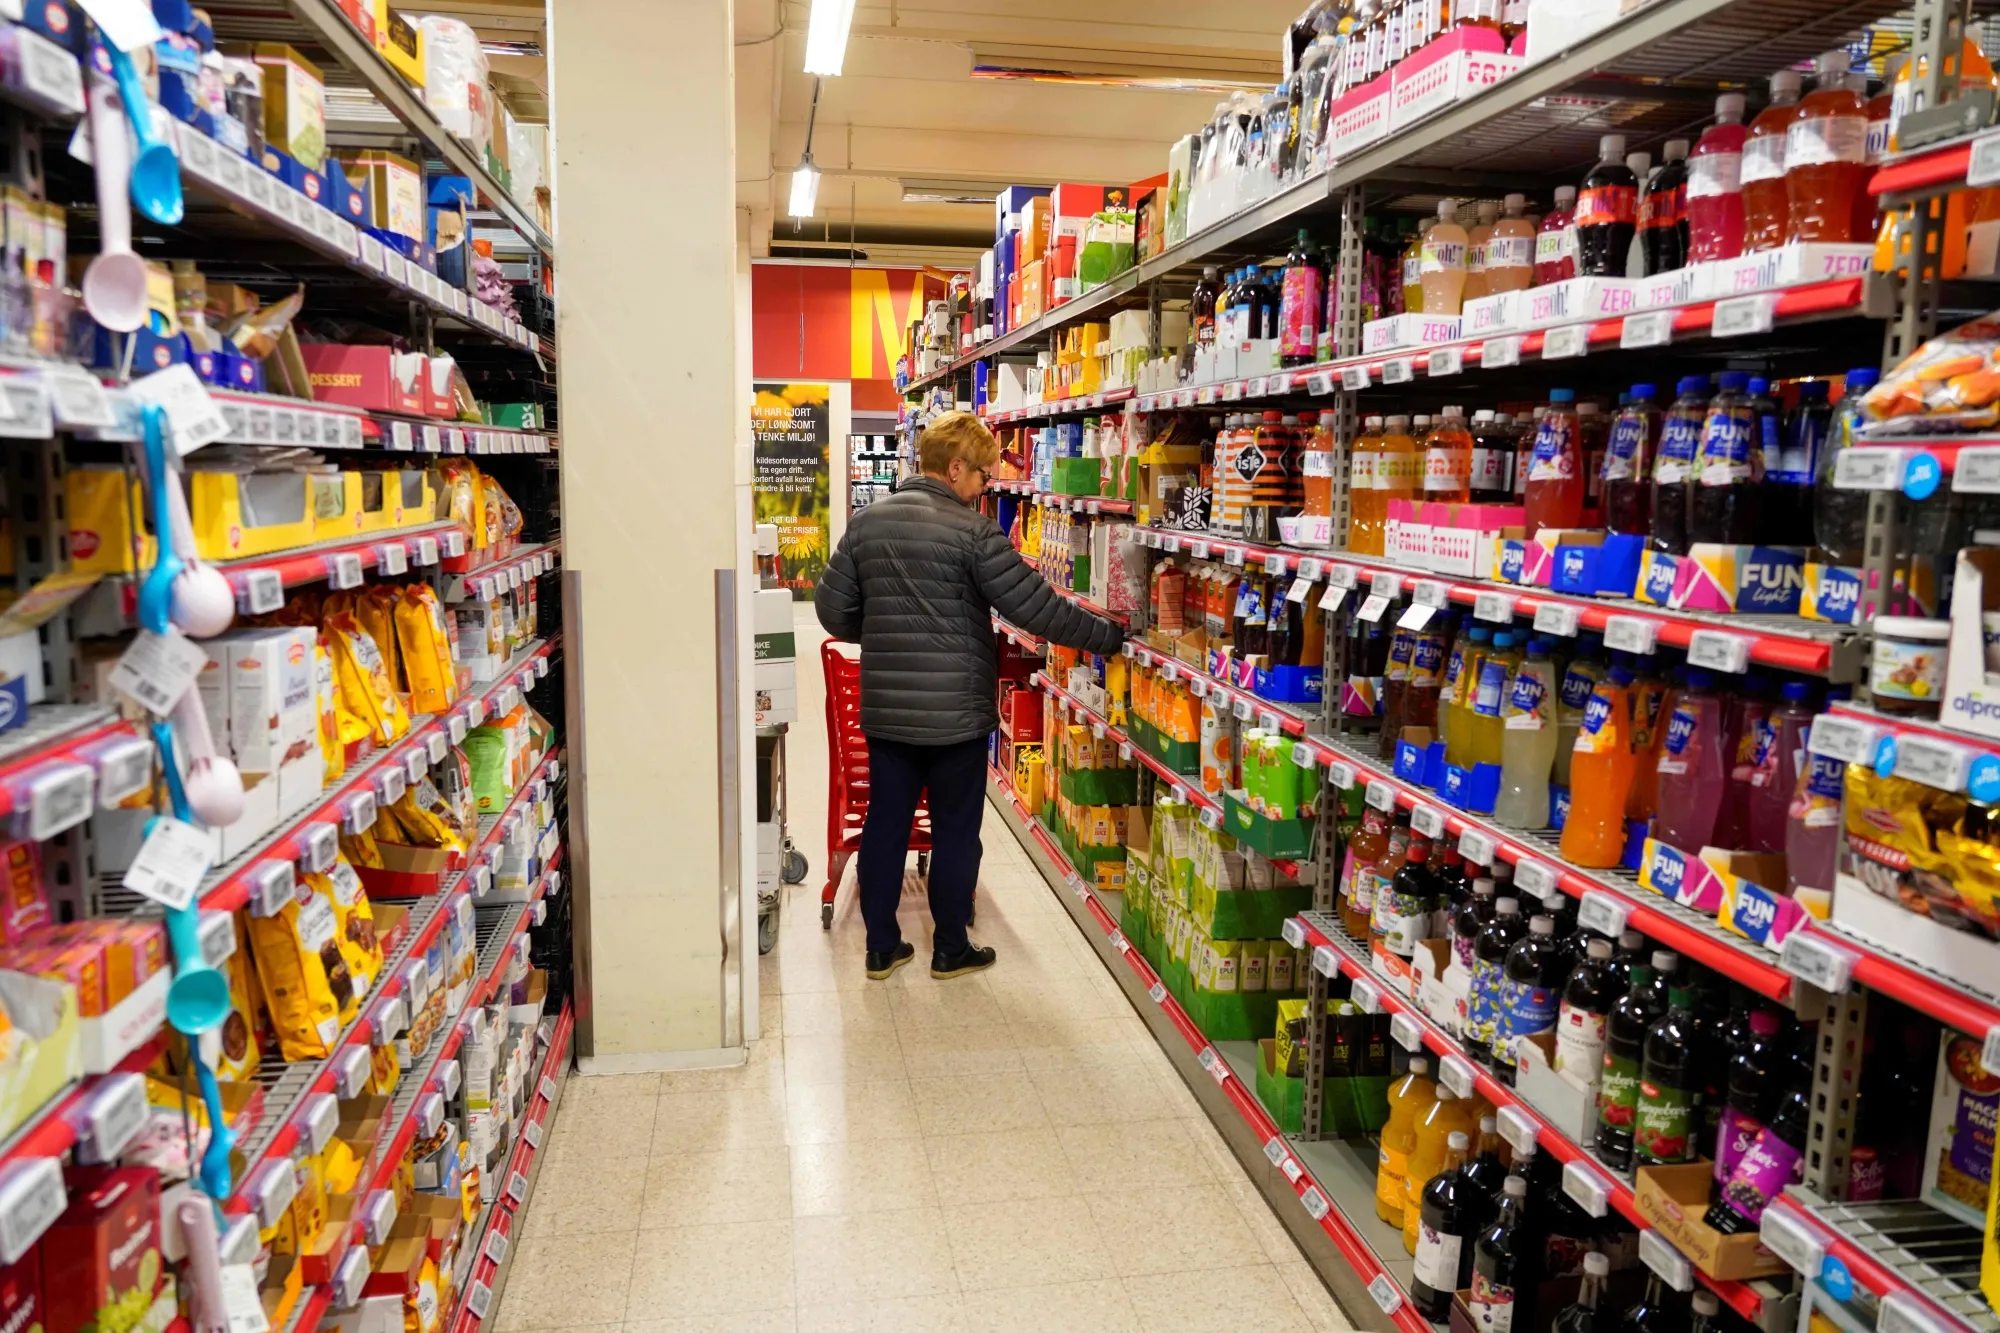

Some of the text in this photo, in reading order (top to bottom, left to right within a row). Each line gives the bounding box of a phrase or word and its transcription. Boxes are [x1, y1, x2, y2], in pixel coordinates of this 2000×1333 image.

[1651, 271, 1694, 305] ZERoh!
[1532, 285, 1569, 320] ZERoh!
[1474, 297, 1507, 330] ZERoh!
[1372, 319, 1400, 347] ZERoh!
[311, 374, 361, 388] DESSERT
[754, 408, 811, 416] VI HAR GJORT
[768, 420, 816, 429] LØNNSOMT
[758, 433, 816, 441] TENKE MILJØ!
[1536, 431, 1565, 446] FUN
[1617, 427, 1642, 441] UN
[1709, 424, 1750, 441] FUN
[756, 457, 818, 465] kildesorterer avfall
[770, 468, 787, 476] egen
[779, 484, 784, 492] å
[770, 516, 798, 524] DET GIR
[782, 536, 799, 544] DEG!
[1502, 548, 1524, 564] FUN
[1565, 557, 1584, 570] FUN
[1651, 563, 1677, 584] FUN
[1741, 563, 1804, 591] FUN
[1752, 588, 1792, 606] light
[1820, 578, 1859, 603] FUN
[1416, 646, 1442, 659] FUN
[1305, 680, 1322, 689] FUN
[1512, 681, 1543, 697] FUN
[1562, 679, 1593, 695] FUN
[1586, 702, 1608, 717] UN
[1669, 718, 1693, 737] UN
[1653, 855, 1686, 880] FUN
[1736, 893, 1775, 922] FUN
